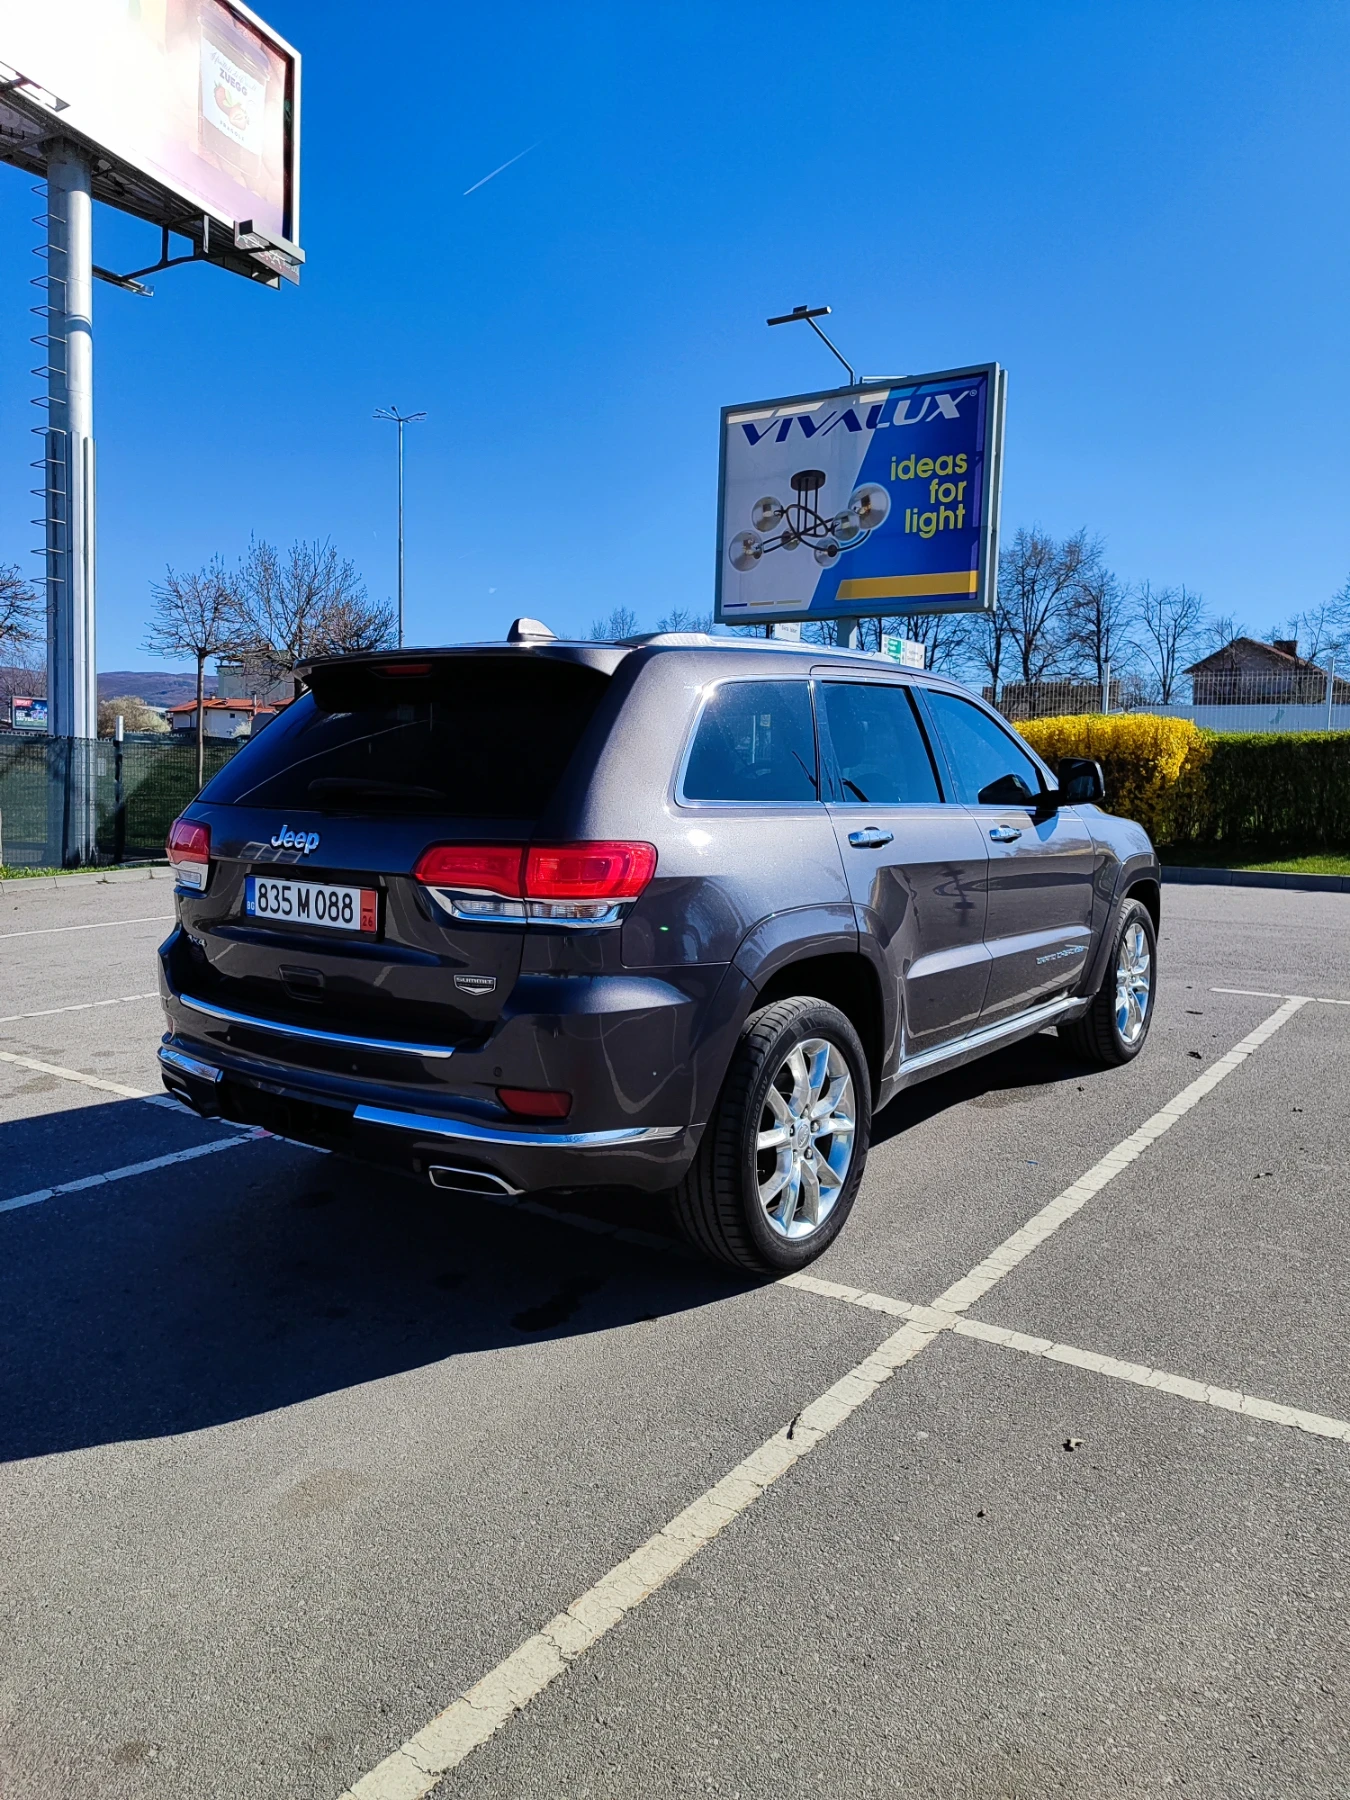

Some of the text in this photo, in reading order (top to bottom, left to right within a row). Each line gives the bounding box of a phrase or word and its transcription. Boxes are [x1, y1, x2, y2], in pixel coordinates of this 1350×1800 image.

[219, 66, 248, 97] ZUEGG
[741, 390, 970, 446] VIVALUX
[890, 453, 968, 481] ideas
[929, 478, 967, 504] for
[904, 503, 966, 539] light
[271, 824, 320, 854] Jeep
[246, 901, 256, 911] BG
[257, 883, 354, 924] 835 M 088
[362, 915, 374, 927] 26
